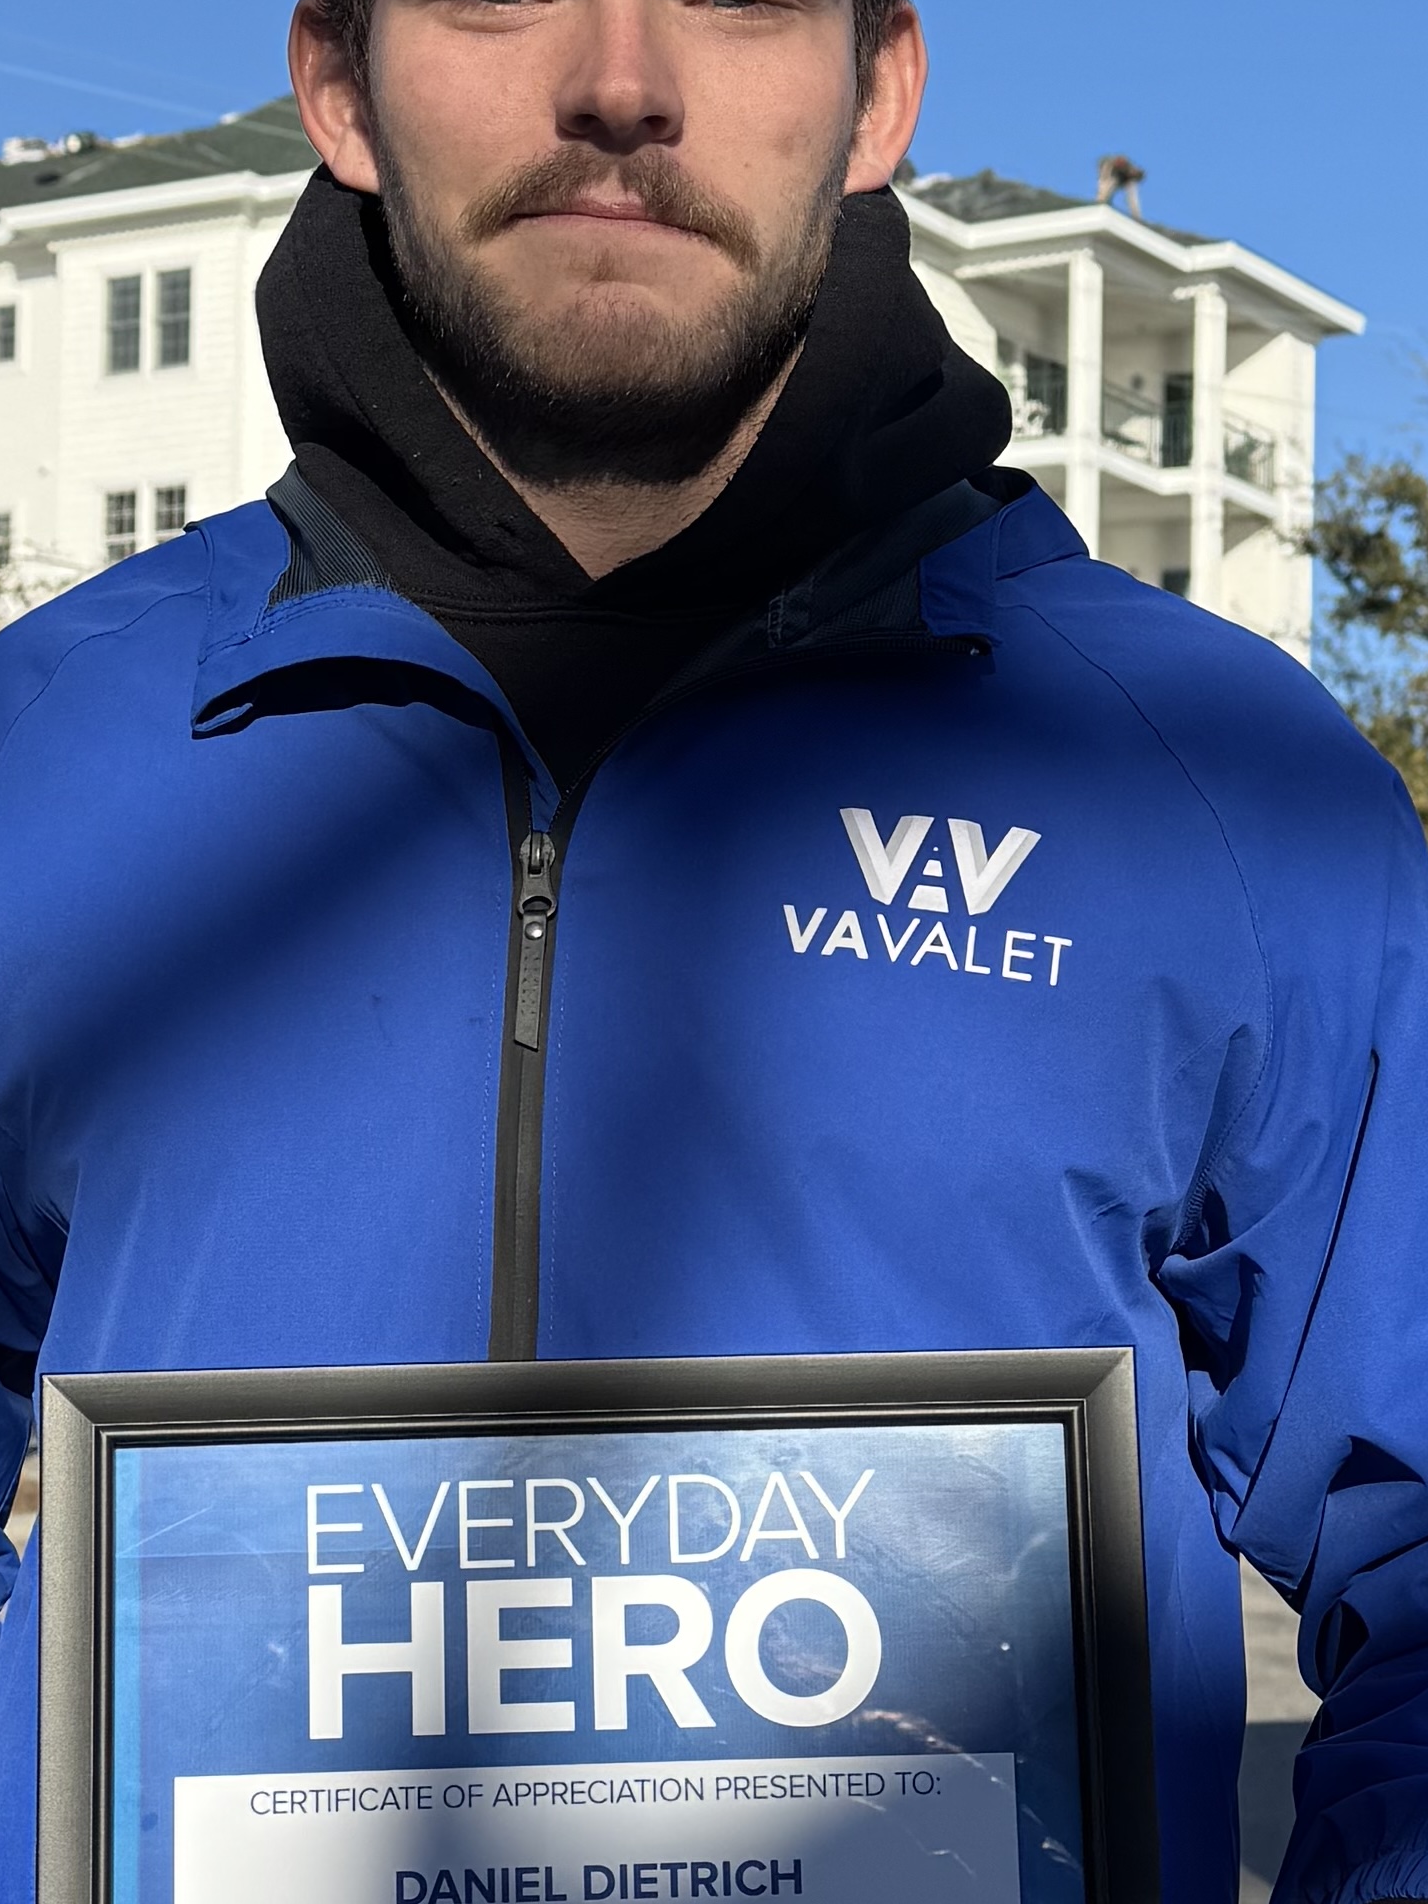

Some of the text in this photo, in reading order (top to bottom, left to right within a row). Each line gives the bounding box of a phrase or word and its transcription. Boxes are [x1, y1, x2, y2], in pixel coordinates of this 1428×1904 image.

[307, 1469, 875, 1575] EVERYDAY
[308, 1568, 883, 1739] HERO
[250, 1771, 942, 1815] CERTIFICATE OF APPRECIATION PRESENTED TO:
[583, 1859, 803, 1901] DIETRICH
